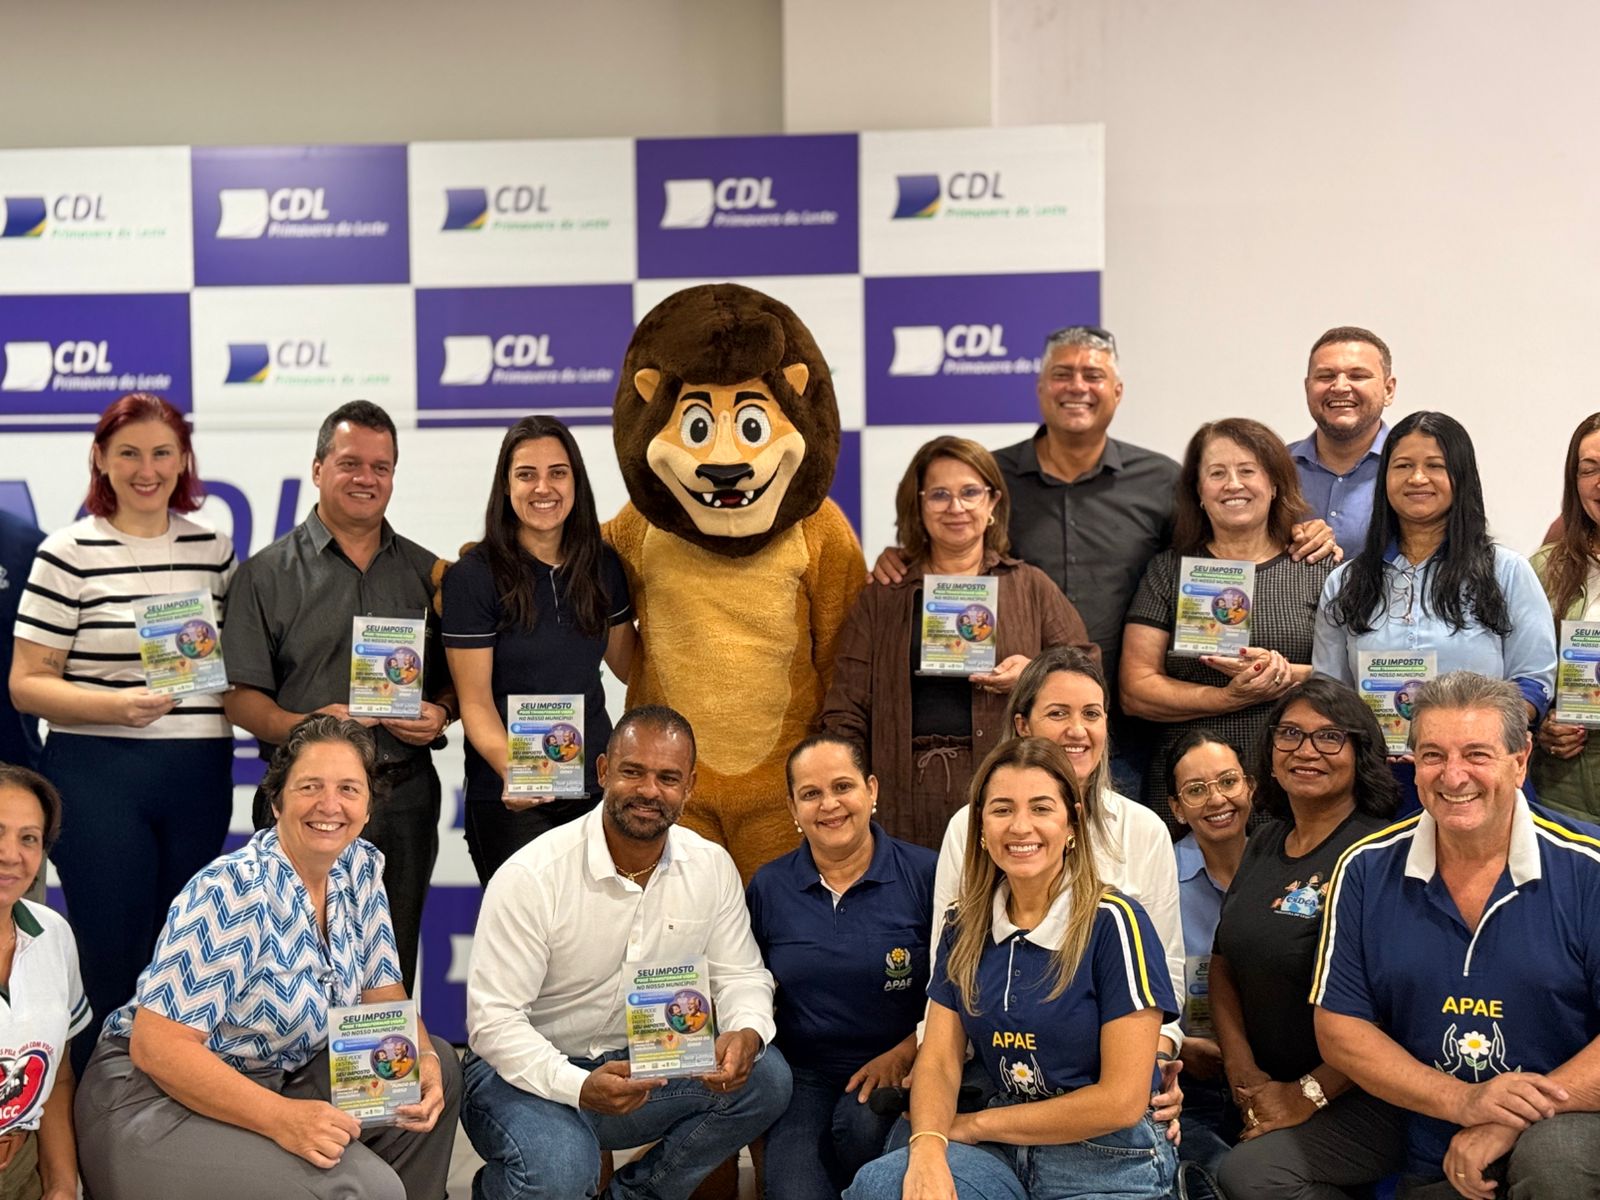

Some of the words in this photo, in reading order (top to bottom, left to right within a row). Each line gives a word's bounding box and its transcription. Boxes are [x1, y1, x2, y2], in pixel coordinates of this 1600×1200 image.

[715, 177, 776, 209] CDL
[947, 171, 1005, 200] CDL
[53, 195, 107, 220] CDL
[270, 188, 328, 220] CDL
[494, 185, 549, 213] CDL
[494, 335, 553, 367] CDL
[945, 324, 1007, 356] CDL
[54, 340, 112, 373] CDL
[276, 341, 330, 367] CDL
[147, 604, 164, 612] SEU
[164, 598, 199, 610] IMPOSTO
[638, 969, 654, 977] SEU
[656, 965, 694, 975] IMPOSTO
[884, 978, 912, 991] APAE
[343, 1015, 361, 1024] SEU
[362, 1010, 402, 1021] IMPOSTO
[1442, 996, 1504, 1018] APAE
[992, 1031, 1037, 1050] APAE
